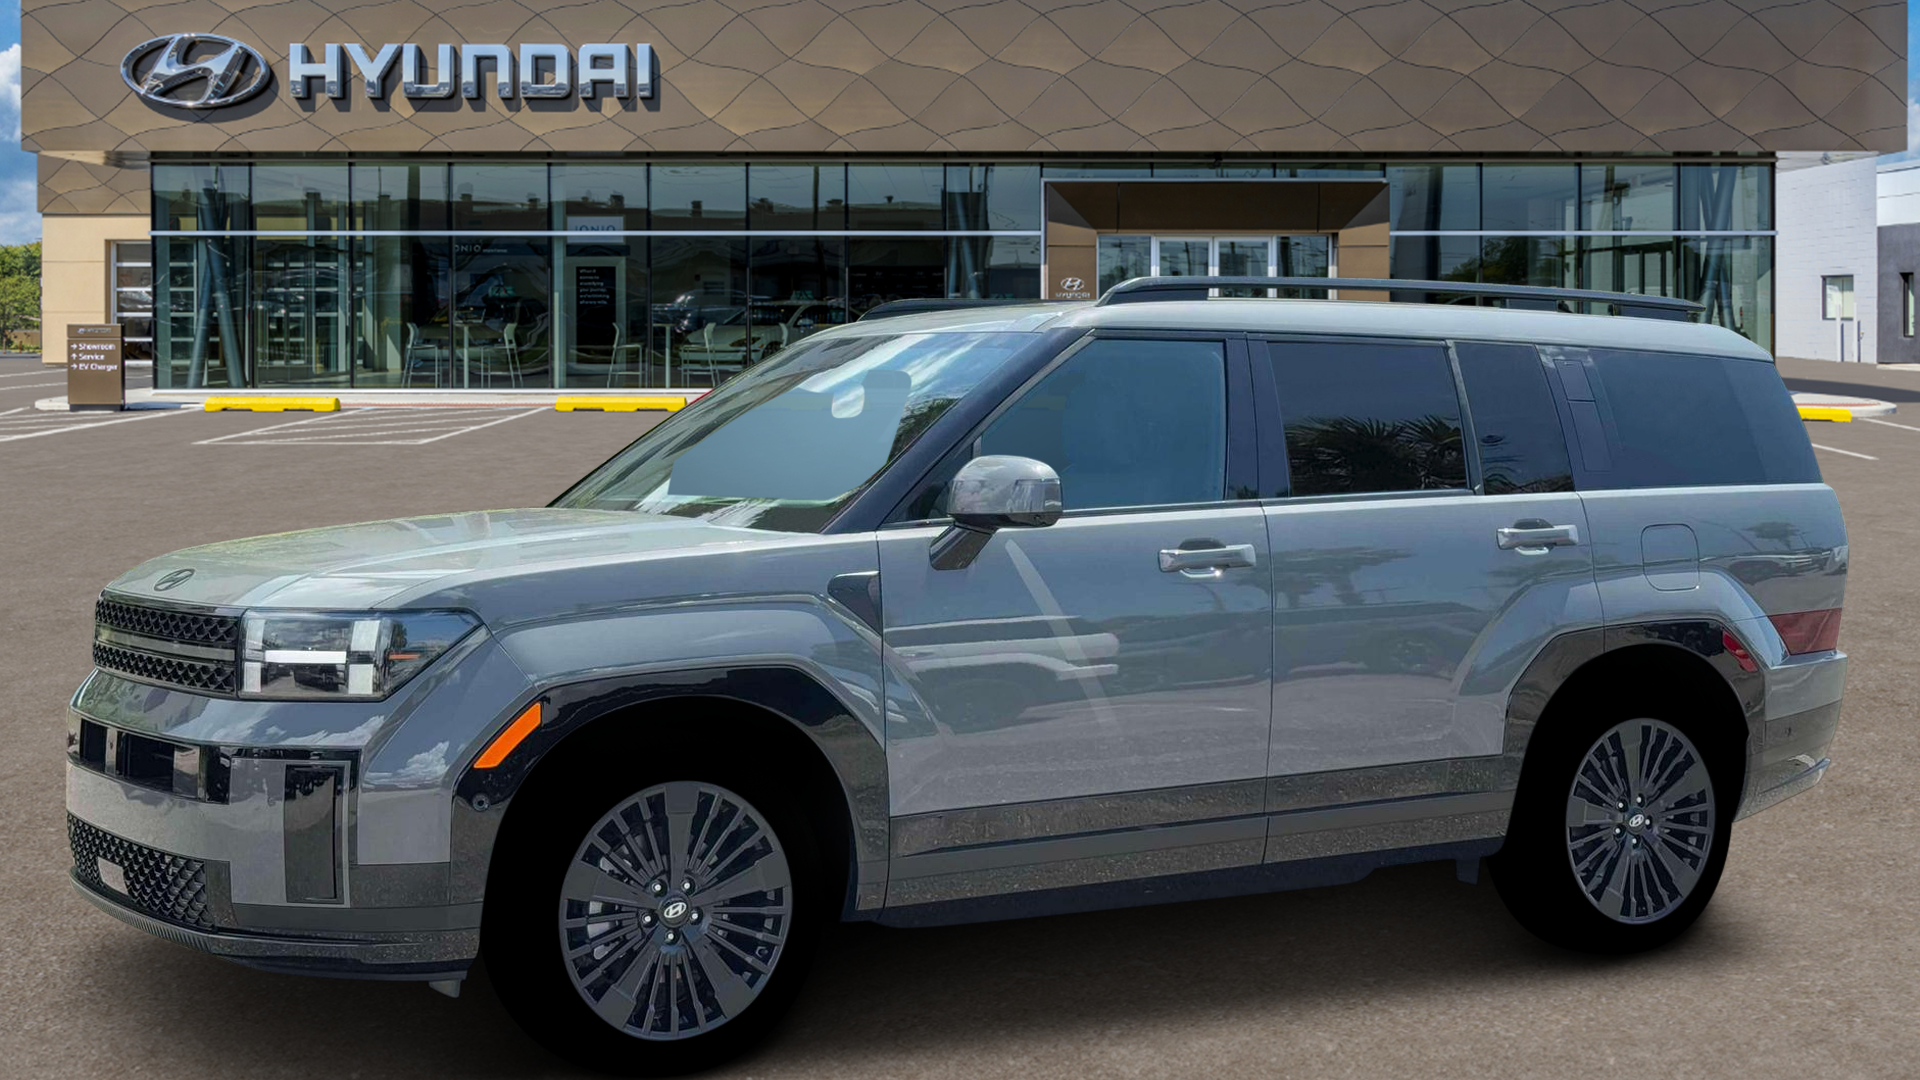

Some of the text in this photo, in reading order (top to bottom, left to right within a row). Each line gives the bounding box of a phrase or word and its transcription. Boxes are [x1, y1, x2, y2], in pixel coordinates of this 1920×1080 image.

[289, 43, 654, 98] HYUNDAI
[78, 352, 104, 360] Service
[90, 363, 118, 372] Charger
